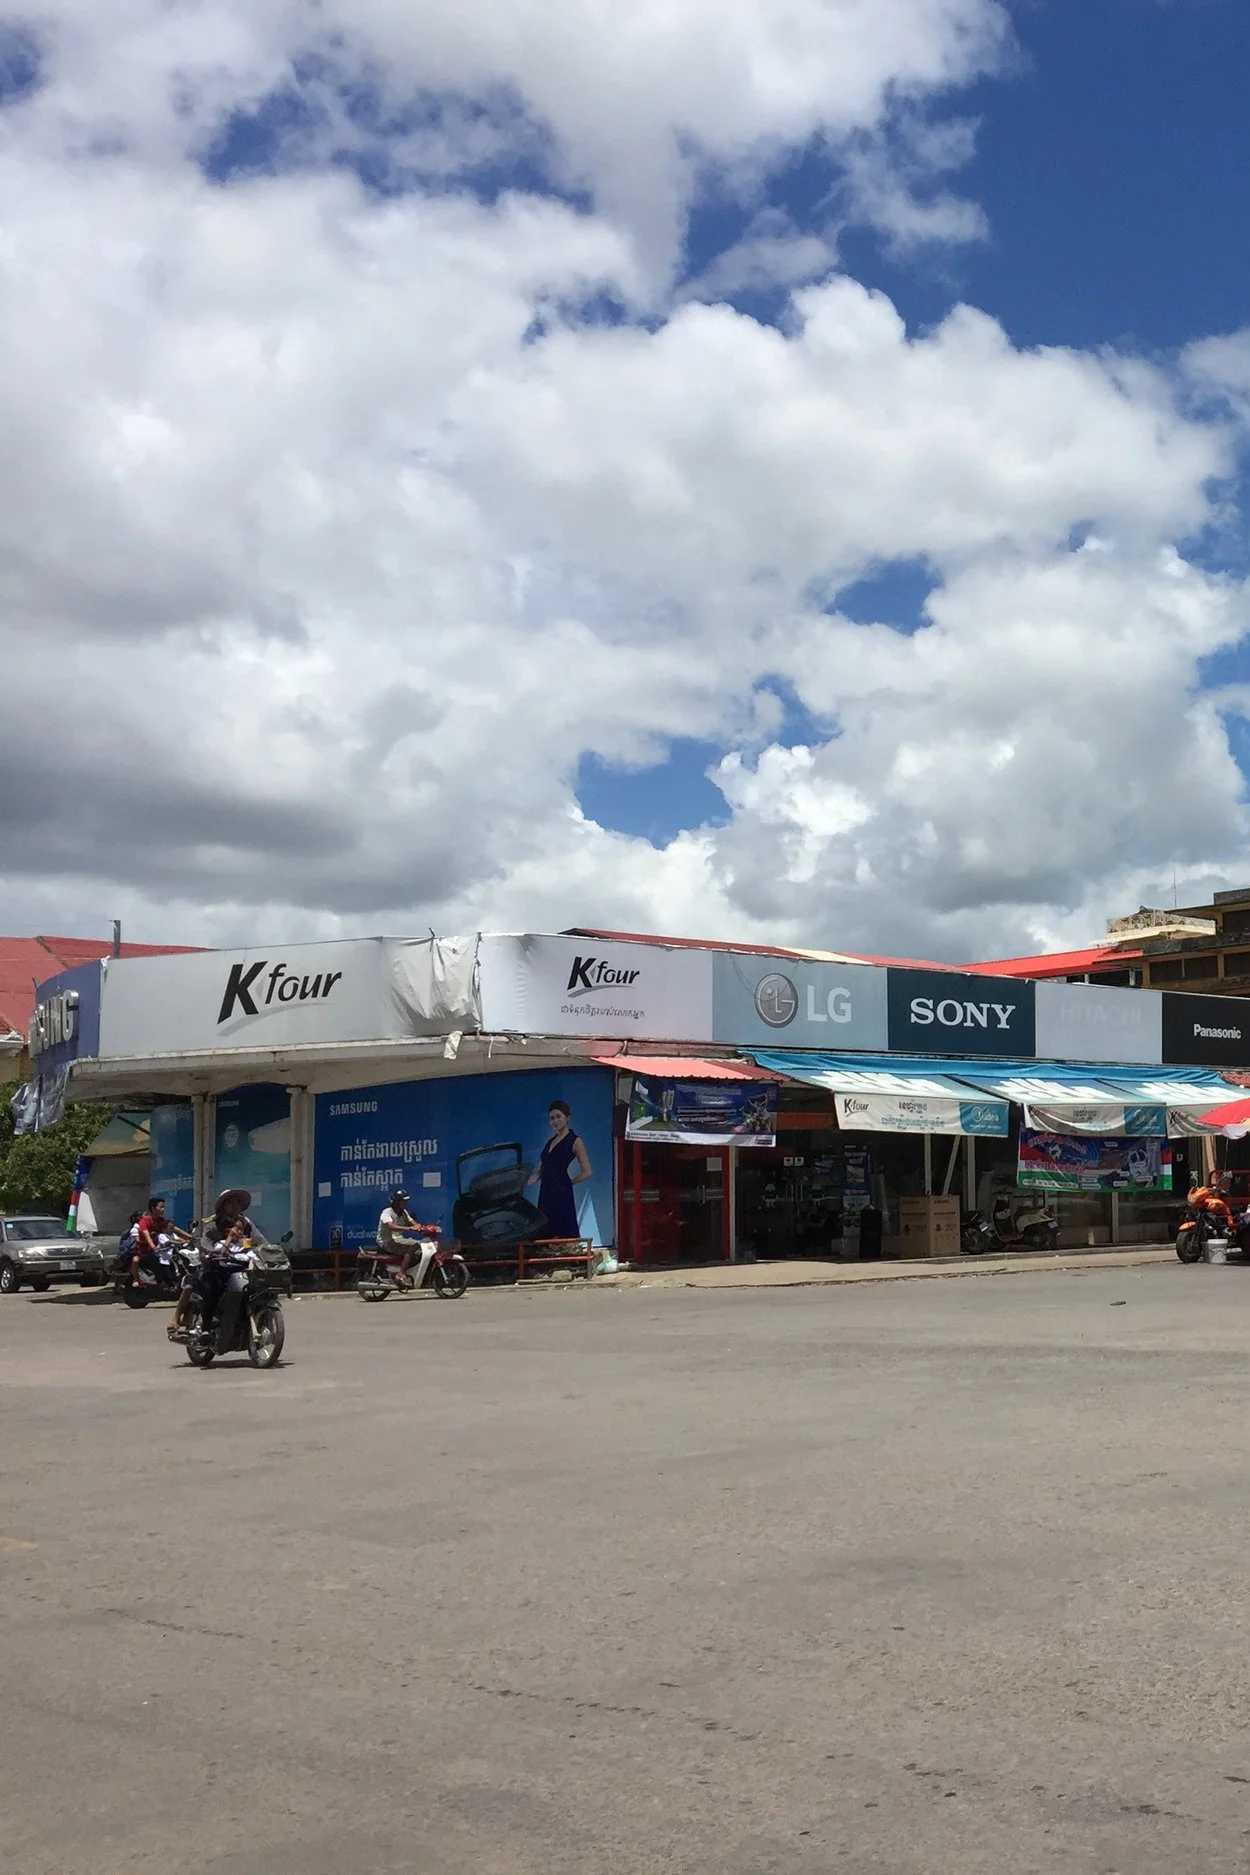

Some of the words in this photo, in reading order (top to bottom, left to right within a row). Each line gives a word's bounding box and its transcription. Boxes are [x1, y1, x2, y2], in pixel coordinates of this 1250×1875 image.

[807, 985, 852, 1023] LG
[910, 998, 1016, 1029] SONY
[1193, 1024, 1242, 1039] Panasonic
[330, 1101, 378, 1116] SAMSUNG
